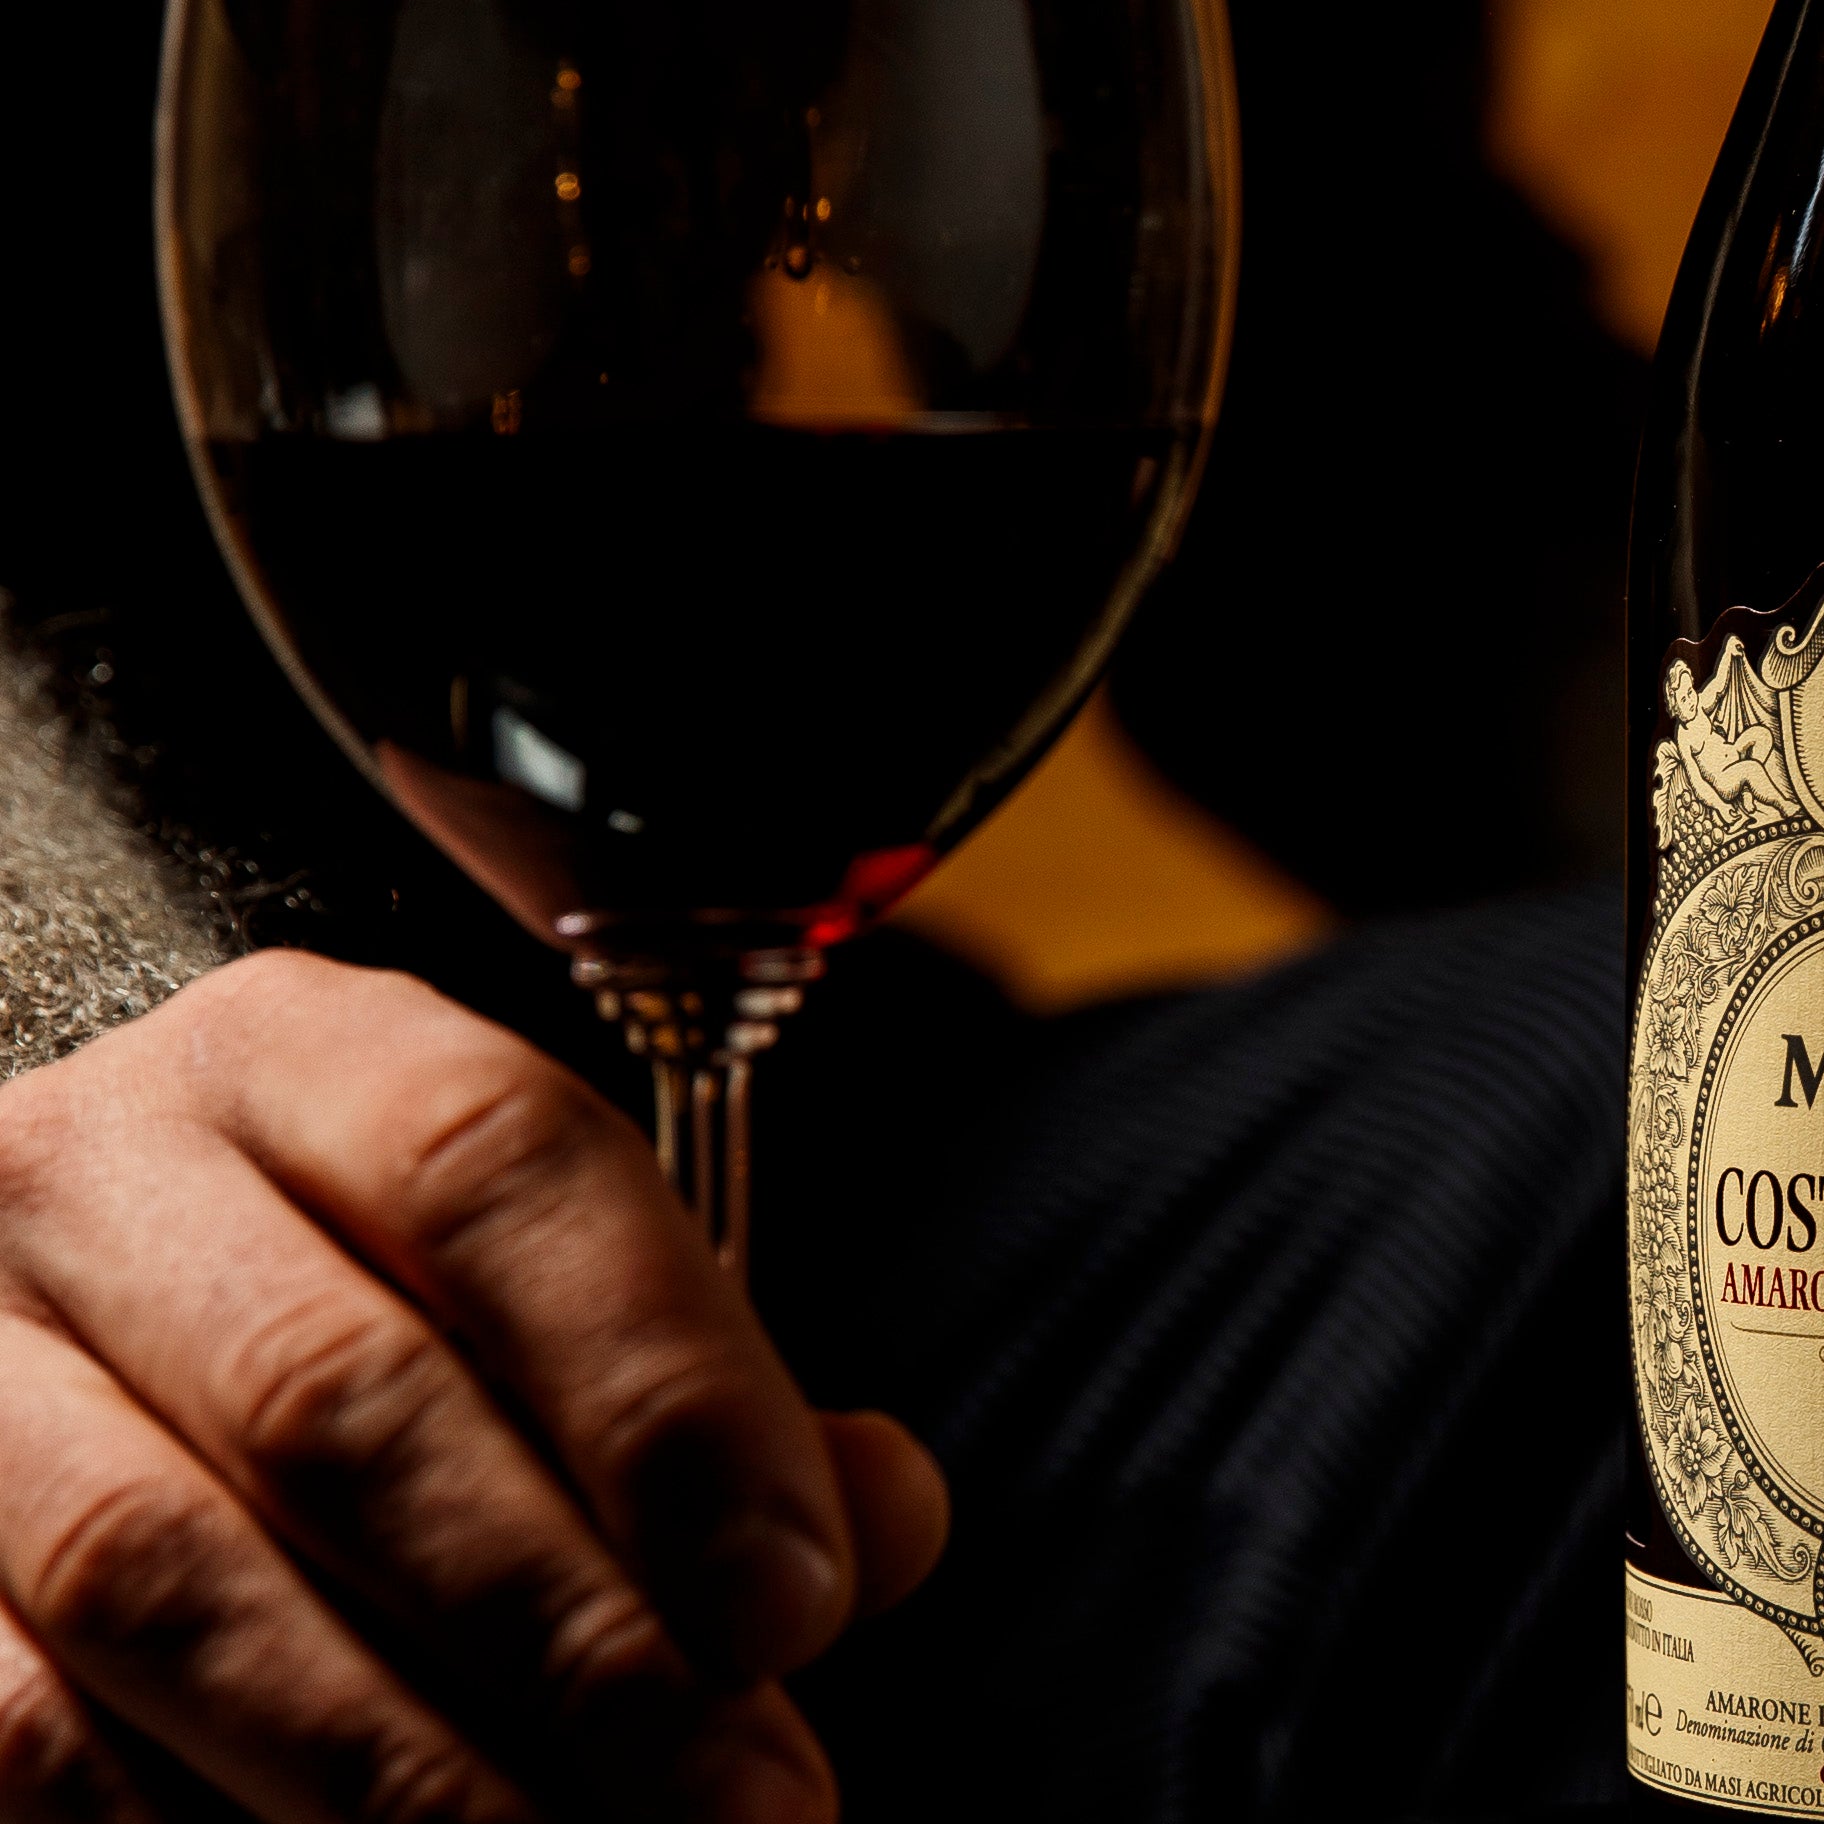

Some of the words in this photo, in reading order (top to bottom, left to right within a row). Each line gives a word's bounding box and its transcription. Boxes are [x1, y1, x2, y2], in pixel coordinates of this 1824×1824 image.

[1662, 1632, 1695, 1663] ITALIA
[1705, 1690, 1811, 1726] AMARONE
[1675, 1709, 1791, 1751] Denominazione
[1795, 1729, 1815, 1754] di
[1684, 1767, 1703, 1789] DA
[1705, 1772, 1742, 1797] MASI
